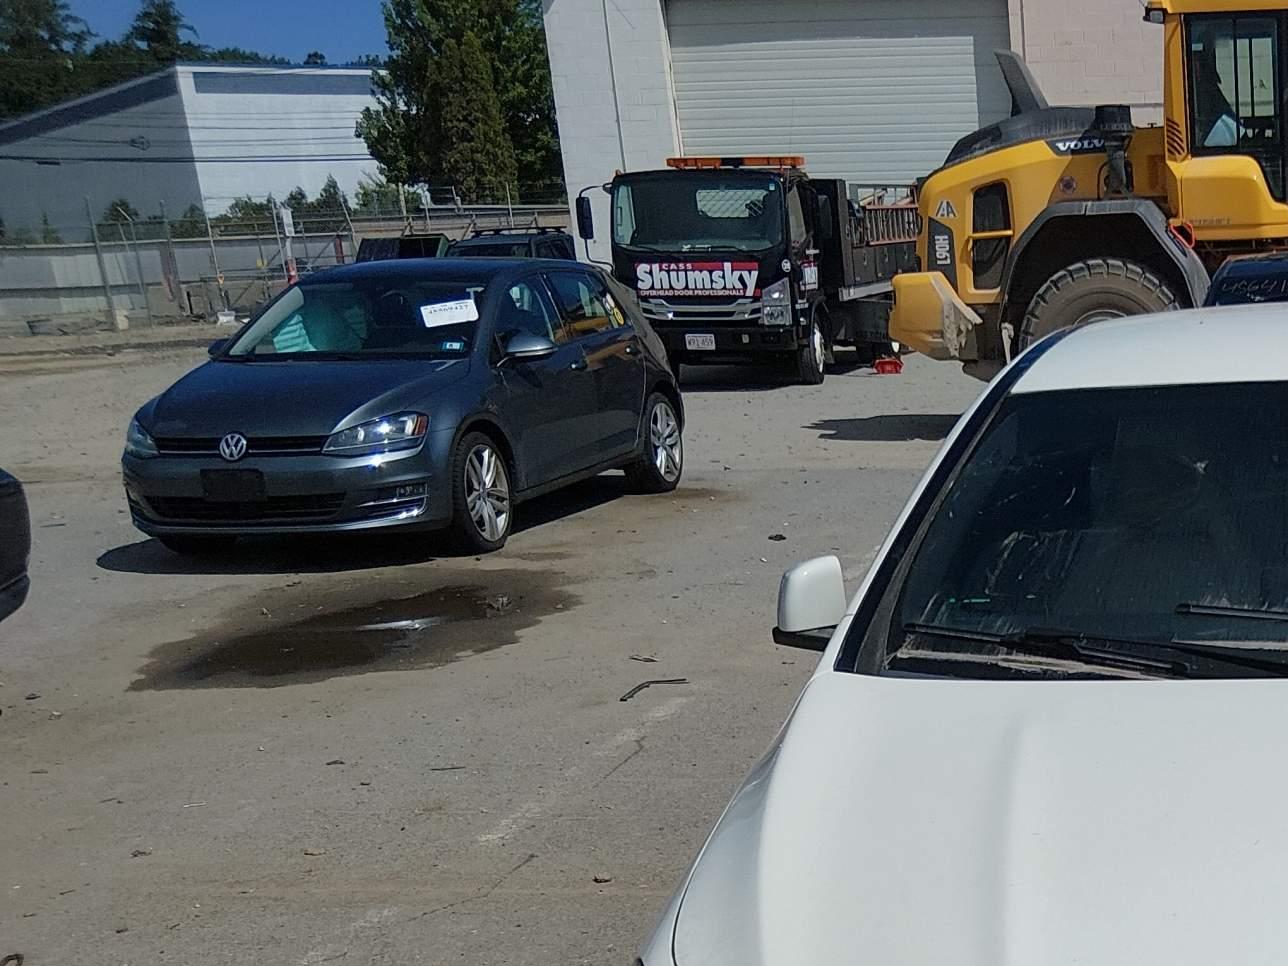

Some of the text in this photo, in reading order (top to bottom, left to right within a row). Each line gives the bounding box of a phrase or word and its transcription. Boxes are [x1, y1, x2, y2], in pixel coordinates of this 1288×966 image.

[1055, 138, 1105, 151] VOLV
[935, 235, 951, 265] L90H
[662, 263, 693, 271] CASS
[636, 262, 759, 297] Shumsky
[640, 289, 744, 297] OVERHEAD DOOR PROFESSIONALS
